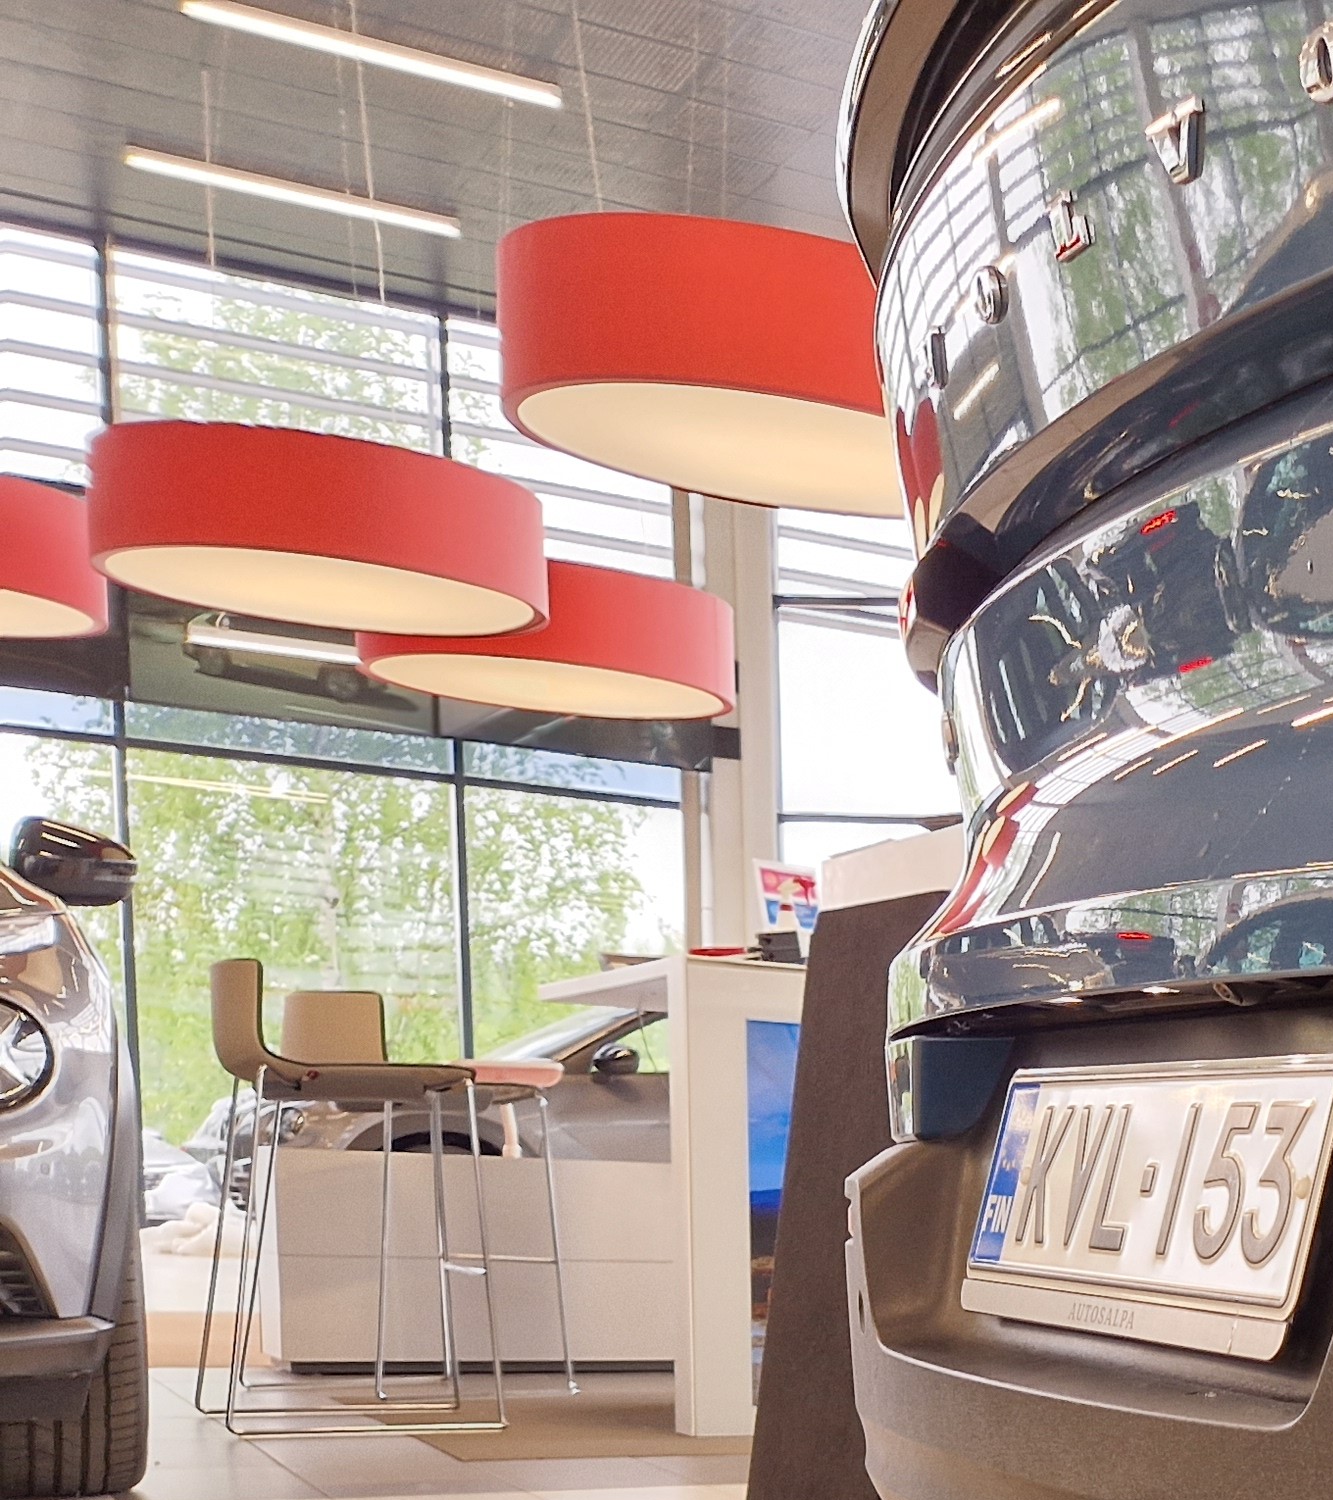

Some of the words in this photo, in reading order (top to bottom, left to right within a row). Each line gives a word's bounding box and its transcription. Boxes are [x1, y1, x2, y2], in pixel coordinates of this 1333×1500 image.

[1014, 1097, 1317, 1267] KVL-153
[981, 1194, 1015, 1234] FIN
[1067, 1302, 1135, 1330] AUTOSALPA
